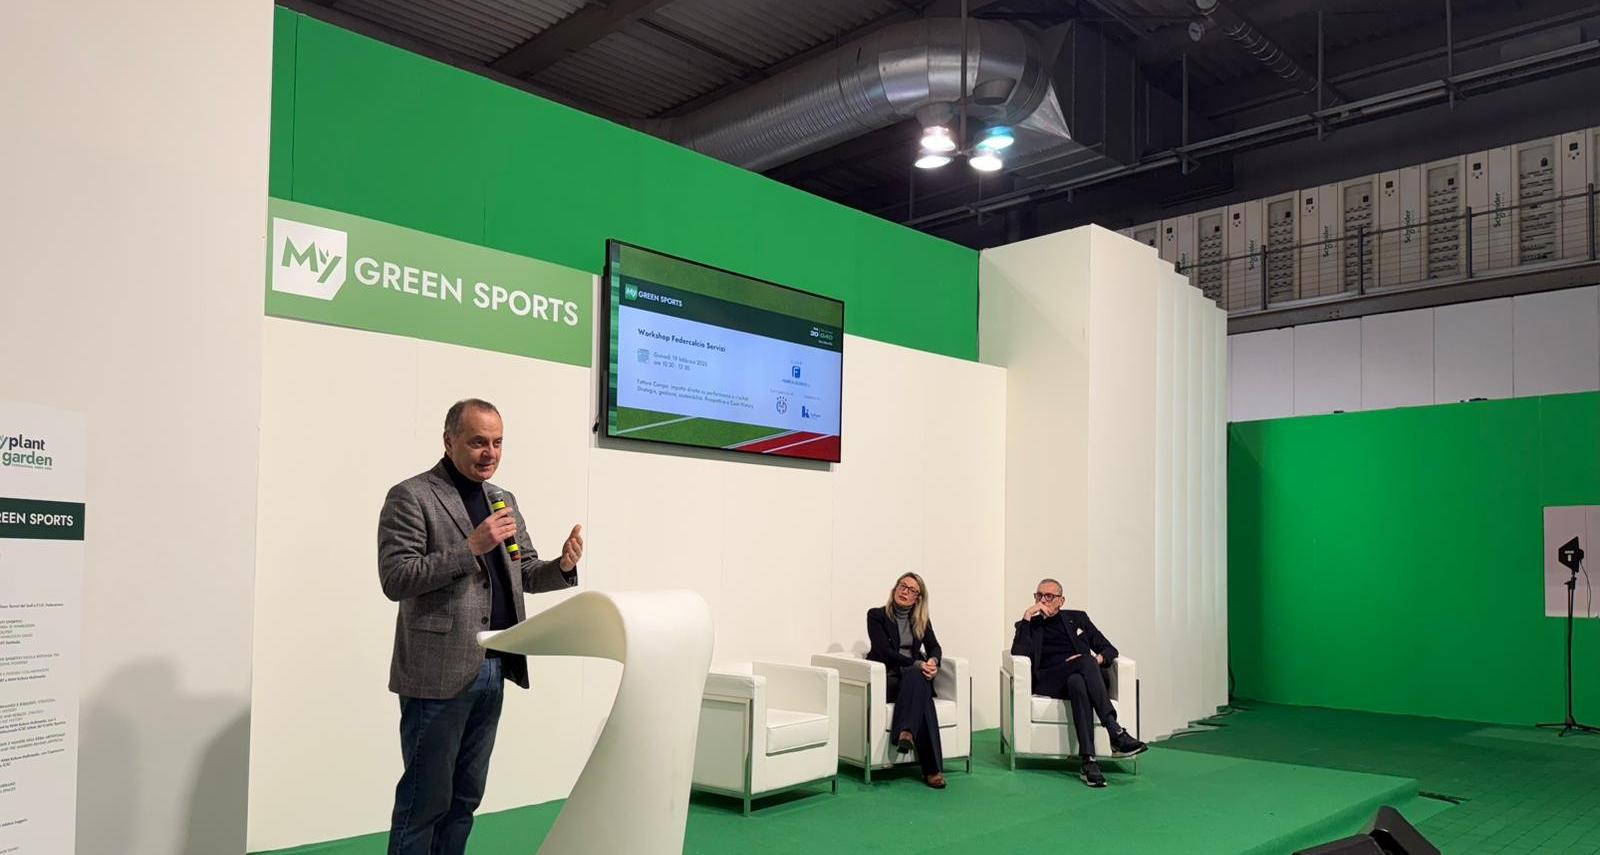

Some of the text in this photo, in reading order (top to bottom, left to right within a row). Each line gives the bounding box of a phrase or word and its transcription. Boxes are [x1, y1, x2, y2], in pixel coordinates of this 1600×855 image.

[354, 257, 463, 304] GREEN
[473, 282, 579, 326] SPORTS
[638, 290, 659, 302] GREEN
[661, 295, 682, 307] SPORTS
[638, 328, 726, 352] Workshop Federcalcio Servizi
[2, 451, 53, 466] garden
[0, 511, 74, 527] EEN SPORTS
